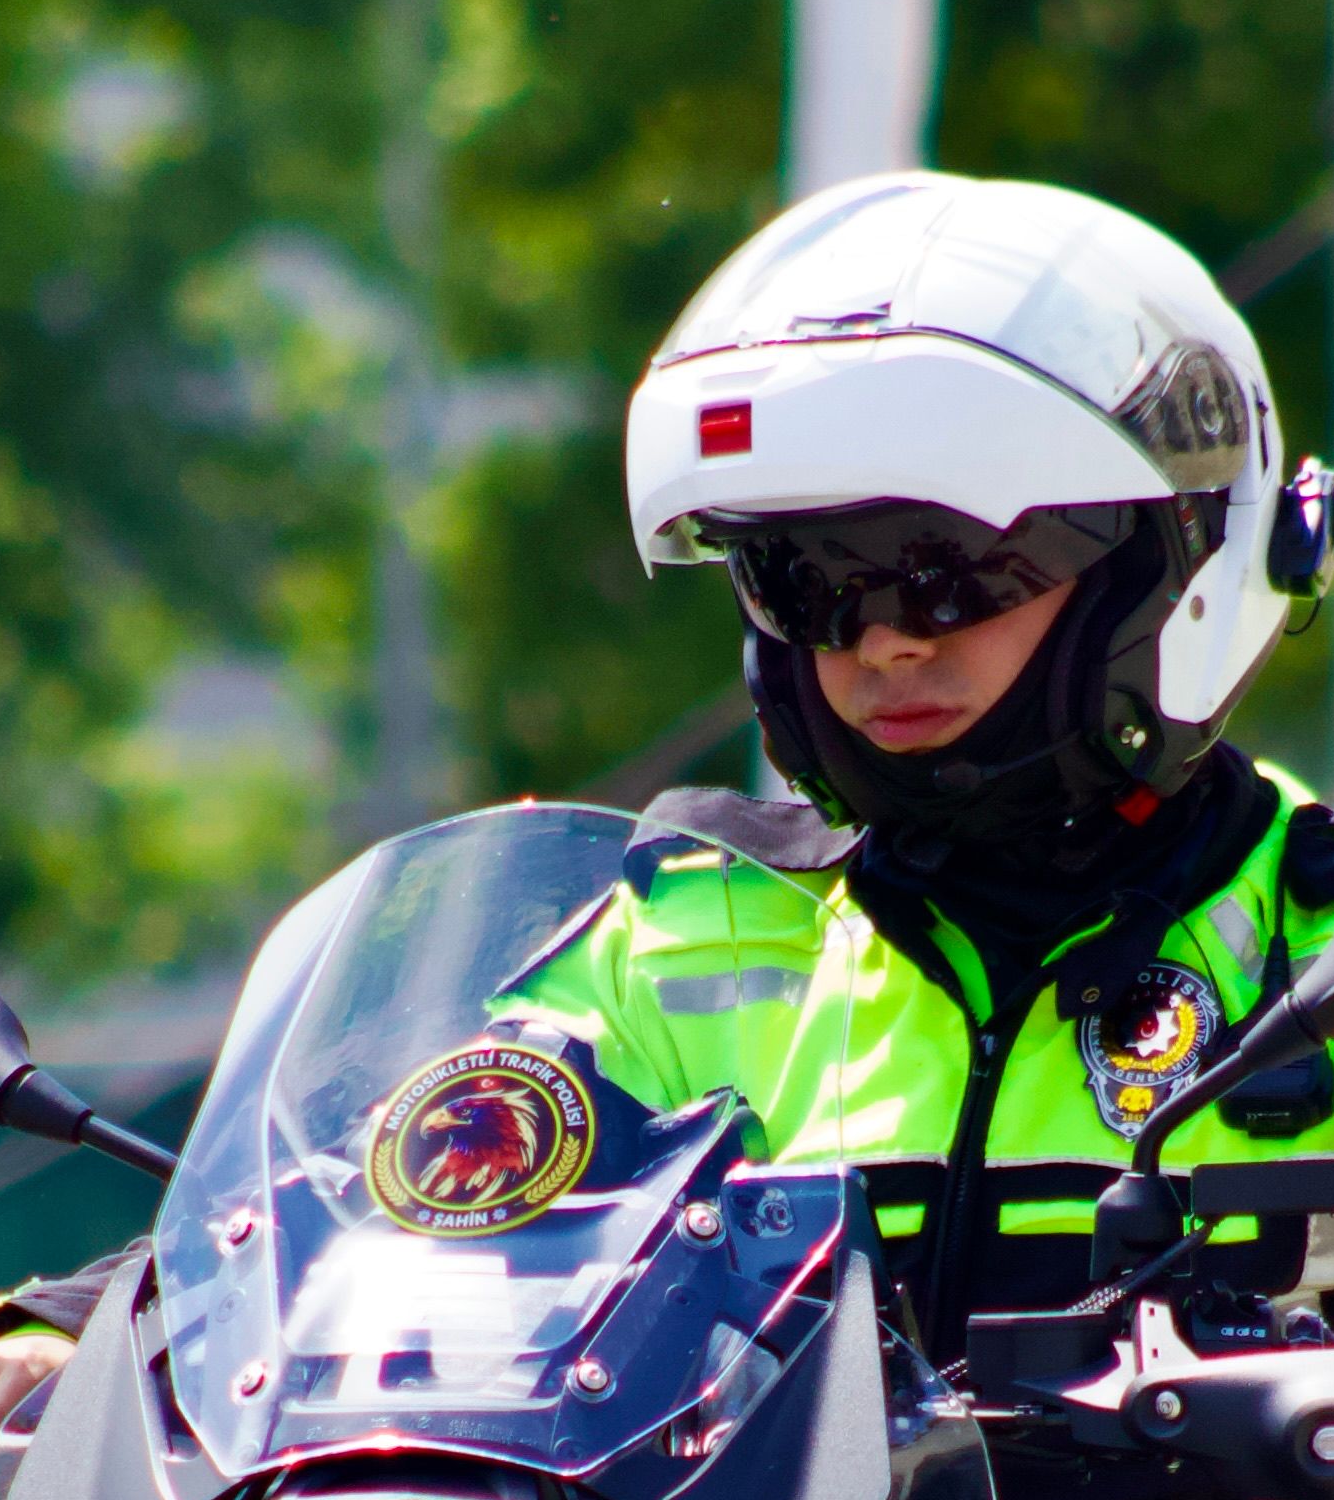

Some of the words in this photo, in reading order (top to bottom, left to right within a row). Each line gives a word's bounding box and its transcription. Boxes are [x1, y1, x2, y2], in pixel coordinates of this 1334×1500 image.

[1137, 972, 1196, 997] OLİS
[1114, 1069, 1166, 1083] GENEL
[385, 1049, 495, 1131] MOTOSİKLETLİ
[499, 1052, 558, 1085] TRAFİK
[550, 1079, 586, 1128] POLİSİ
[432, 1211, 489, 1230] ŞAHİN
